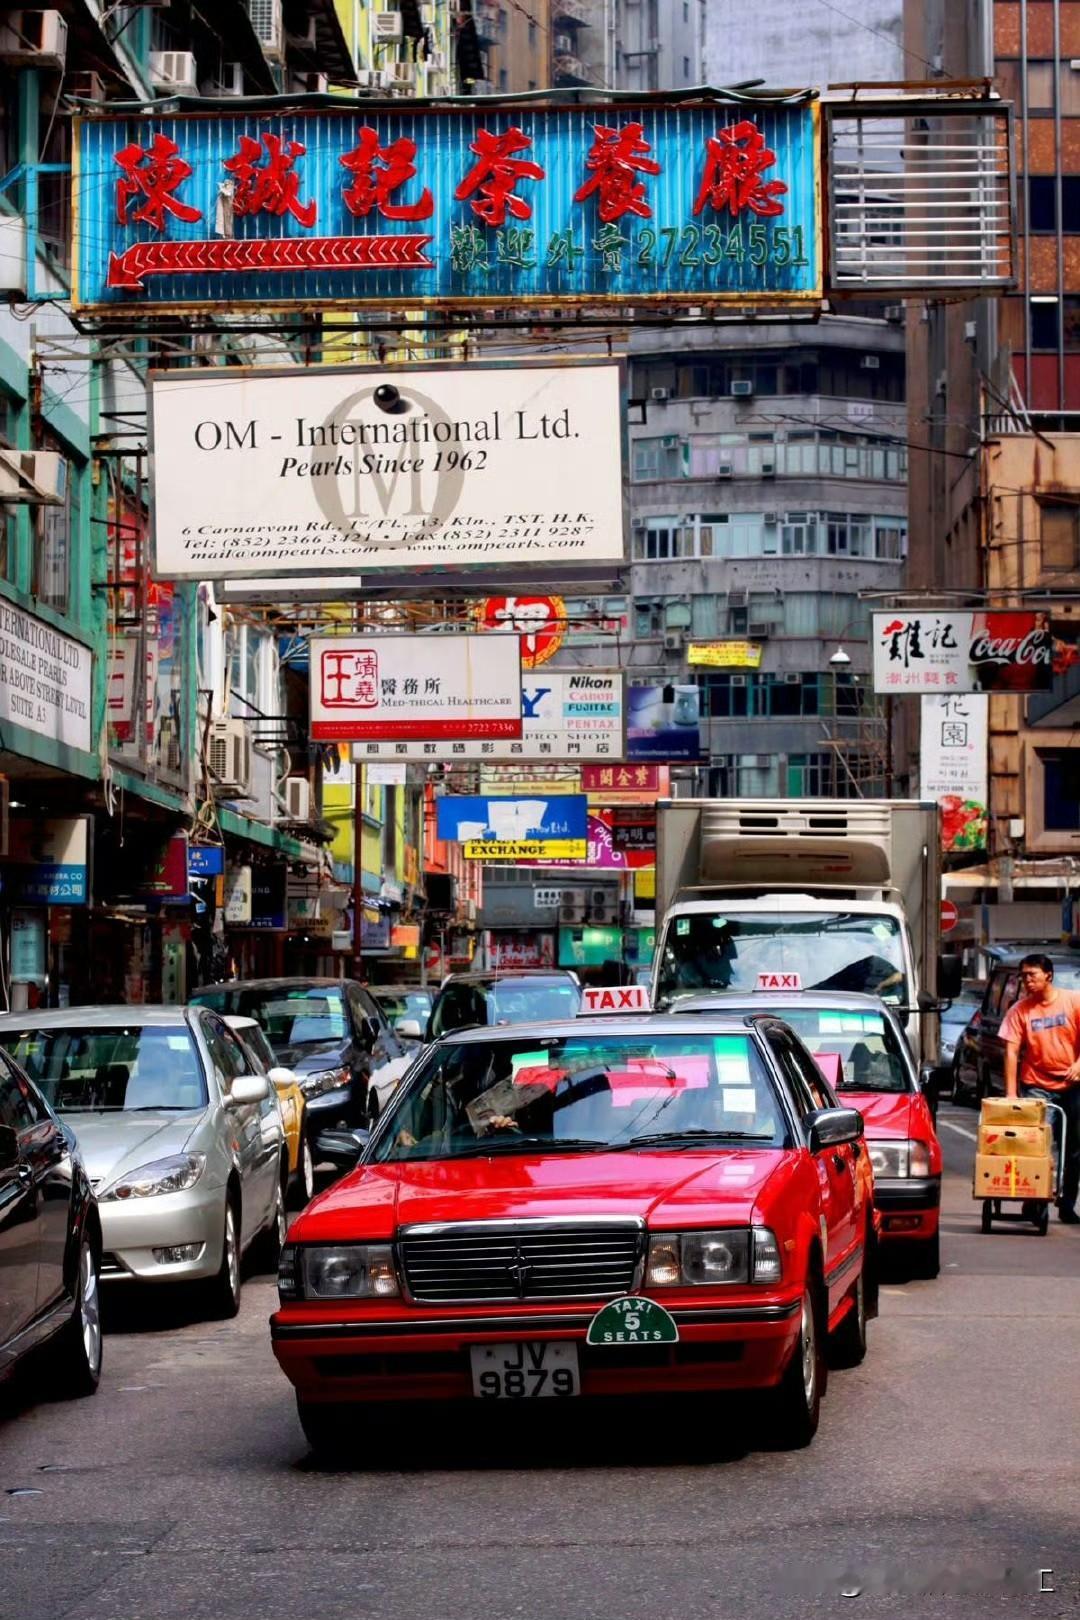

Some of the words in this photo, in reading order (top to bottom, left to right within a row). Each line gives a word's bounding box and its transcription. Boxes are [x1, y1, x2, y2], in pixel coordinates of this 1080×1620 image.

[114, 120, 788, 229] 陳誠記茶餐廳
[450, 223, 626, 272] 歡迎外賣
[638, 224, 808, 266] 27234551
[194, 419, 258, 451] OM
[297, 413, 499, 447] International
[517, 410, 580, 441] Ltd.
[280, 455, 352, 478] Pearls
[360, 453, 424, 475] Since
[433, 451, 487, 473] 1962
[181, 526, 191, 535] 6
[198, 524, 299, 535] Carnarvon
[184, 539, 217, 549] Tel:
[223, 537, 271, 548] (852)
[278, 535, 322, 545] 2366
[401, 531, 437, 541] Fax
[443, 529, 492, 540] (852)
[498, 527, 541, 538] 2311
[549, 526, 594, 537] 9287
[191, 546, 379, 559] mail@ompearls.com
[407, 539, 586, 551] www.ompearls.com
[38, 657, 68, 686] PEARLS
[9, 667, 36, 695] ABOVE
[36, 681, 64, 709] STREET
[381, 677, 441, 695] 醫務所
[569, 676, 612, 689] Nikon
[569, 692, 614, 701] Canon
[10, 694, 34, 719] SUITE
[36, 704, 46, 723] A3
[468, 723, 489, 732] 2722
[567, 719, 614, 729] PENTAX
[471, 846, 546, 855] EXCHANGE
[760, 975, 797, 987] TAXI
[585, 989, 642, 1009] TAXI
[611, 1299, 652, 1314] TAXI
[624, 1312, 641, 1330] 5
[603, 1330, 662, 1342] SEATS
[504, 1343, 547, 1370] JV
[479, 1367, 574, 1399] 9879
